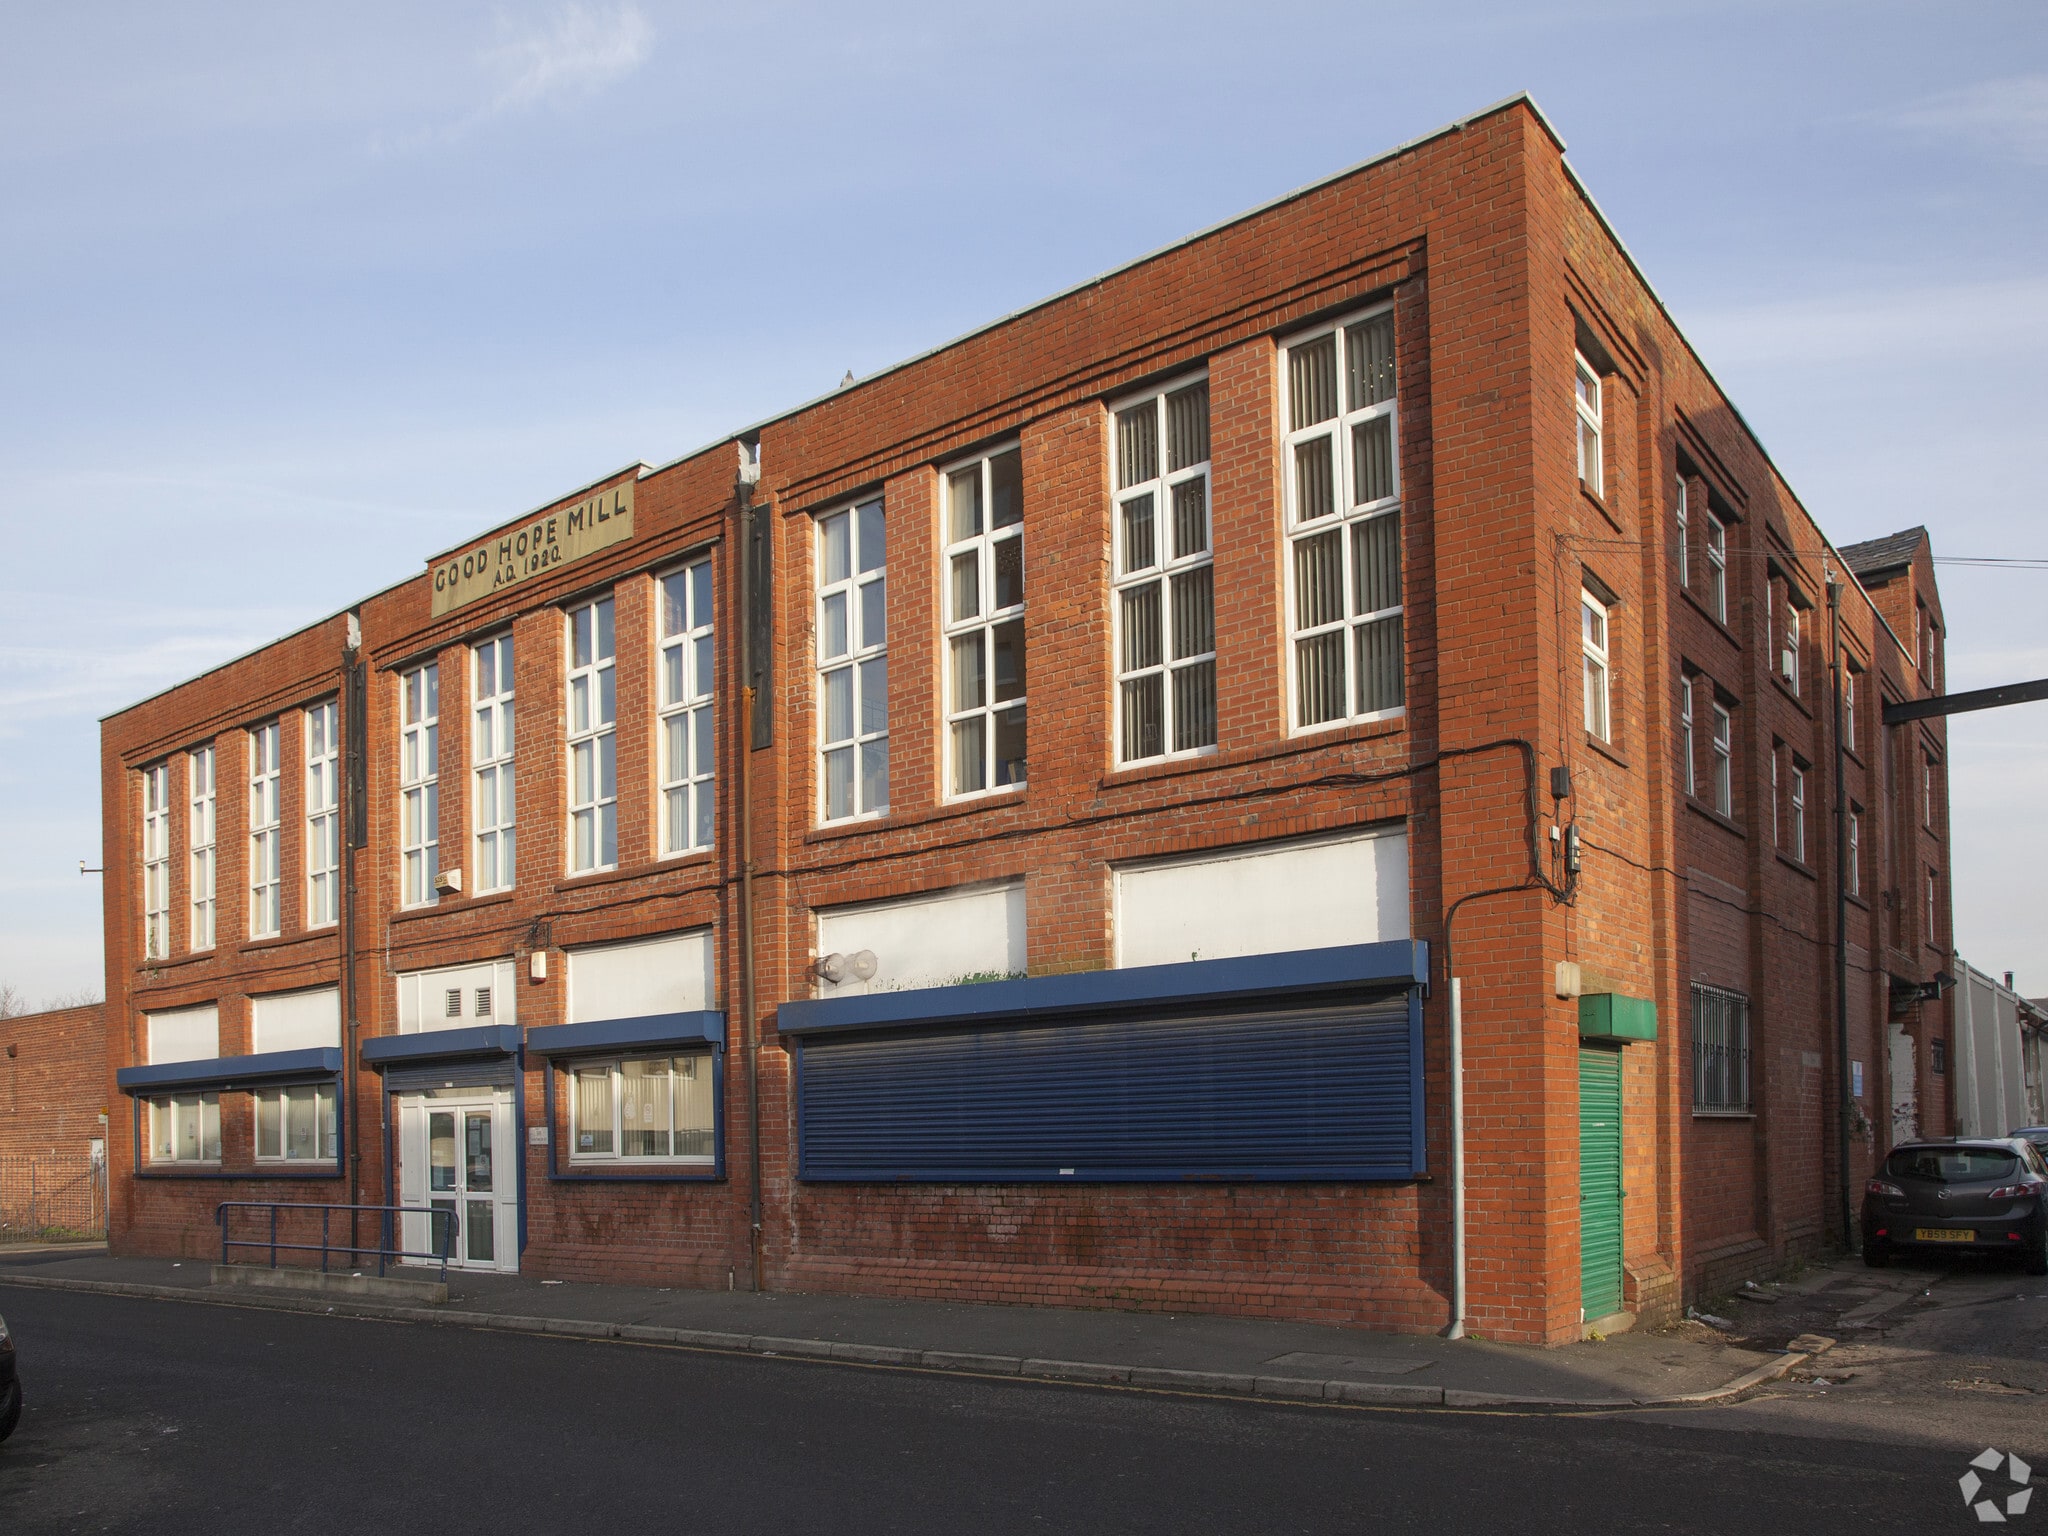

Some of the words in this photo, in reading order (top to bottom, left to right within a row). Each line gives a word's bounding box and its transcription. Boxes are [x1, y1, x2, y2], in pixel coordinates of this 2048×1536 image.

[435, 549, 488, 592] GOOD
[499, 518, 558, 565] HOPE
[567, 490, 627, 536] MILL
[1920, 1229, 1947, 1239] YB59
[1949, 1230, 1970, 1240] SFY
